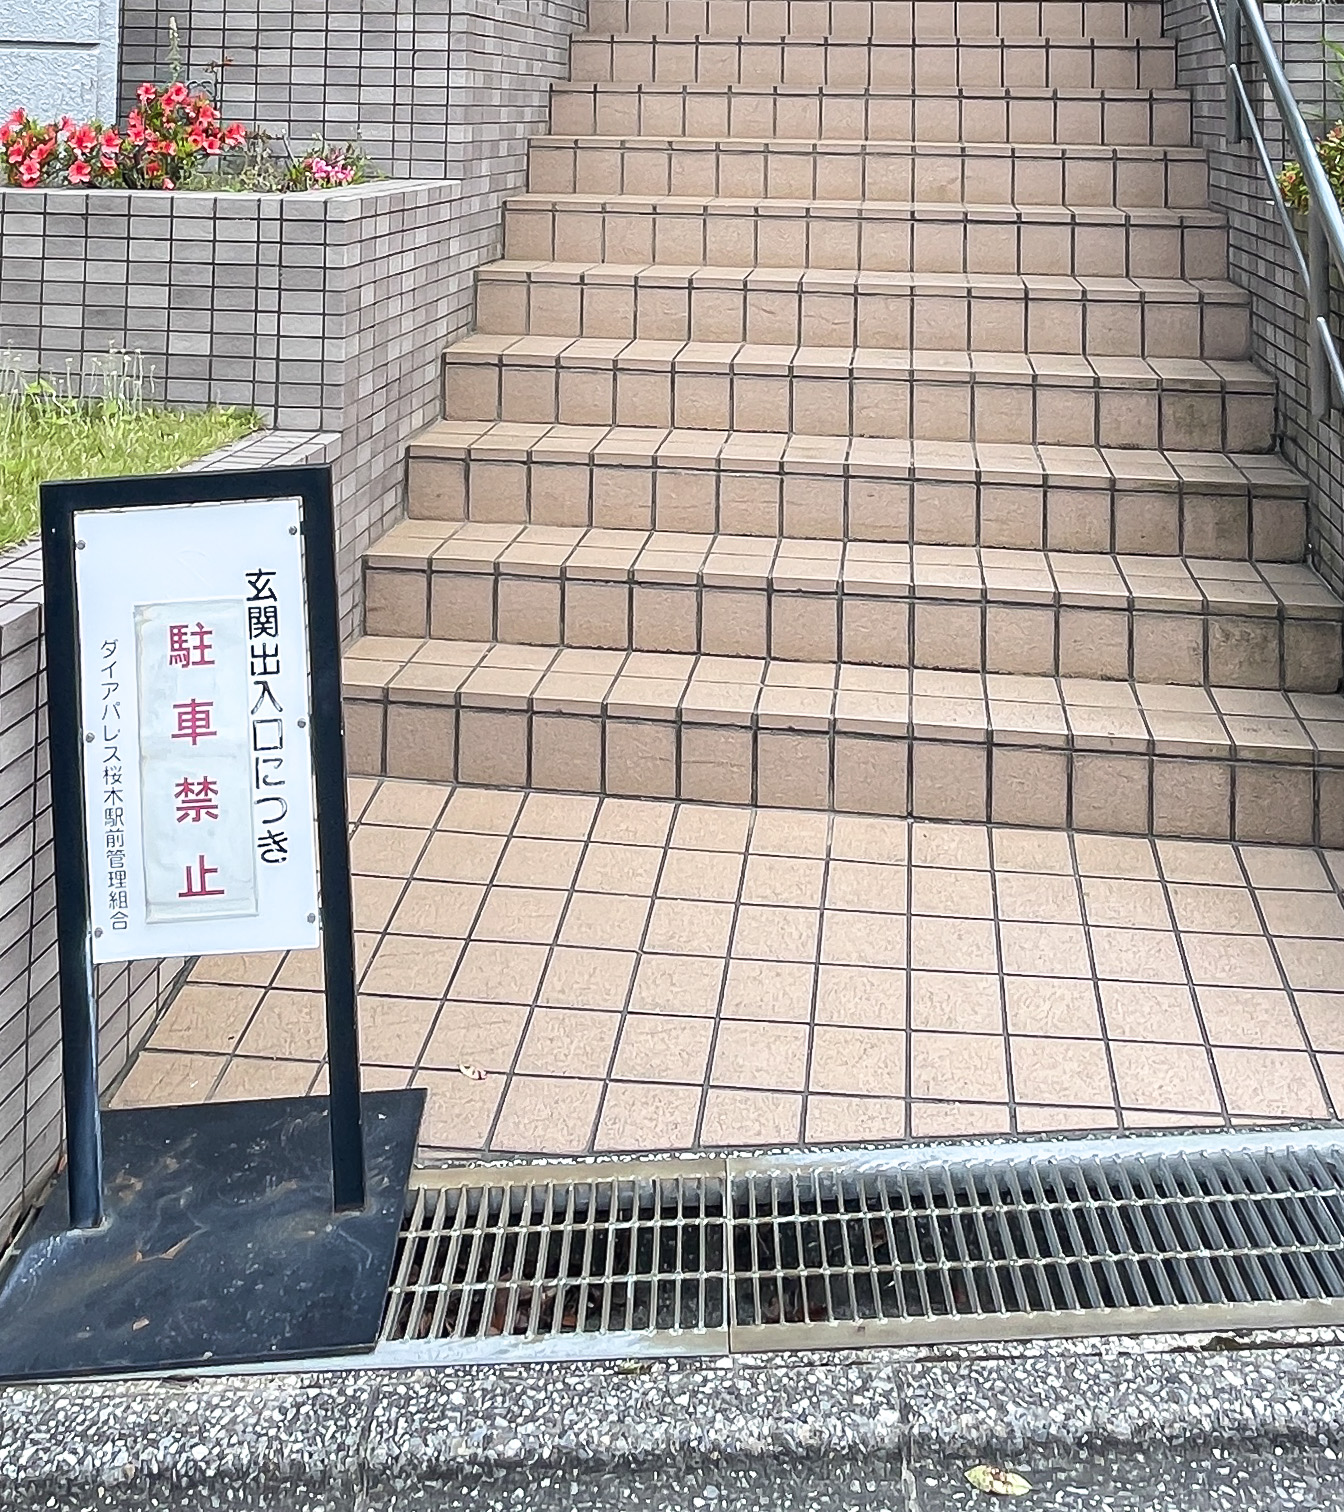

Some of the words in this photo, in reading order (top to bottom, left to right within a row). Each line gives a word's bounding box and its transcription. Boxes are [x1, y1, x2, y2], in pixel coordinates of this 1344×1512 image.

[99, 638, 130, 932] ダイアパレス桜木駅前管理組合
[168, 621, 225, 899] 駐車禁止
[244, 567, 290, 865] 玄関出入口につき
